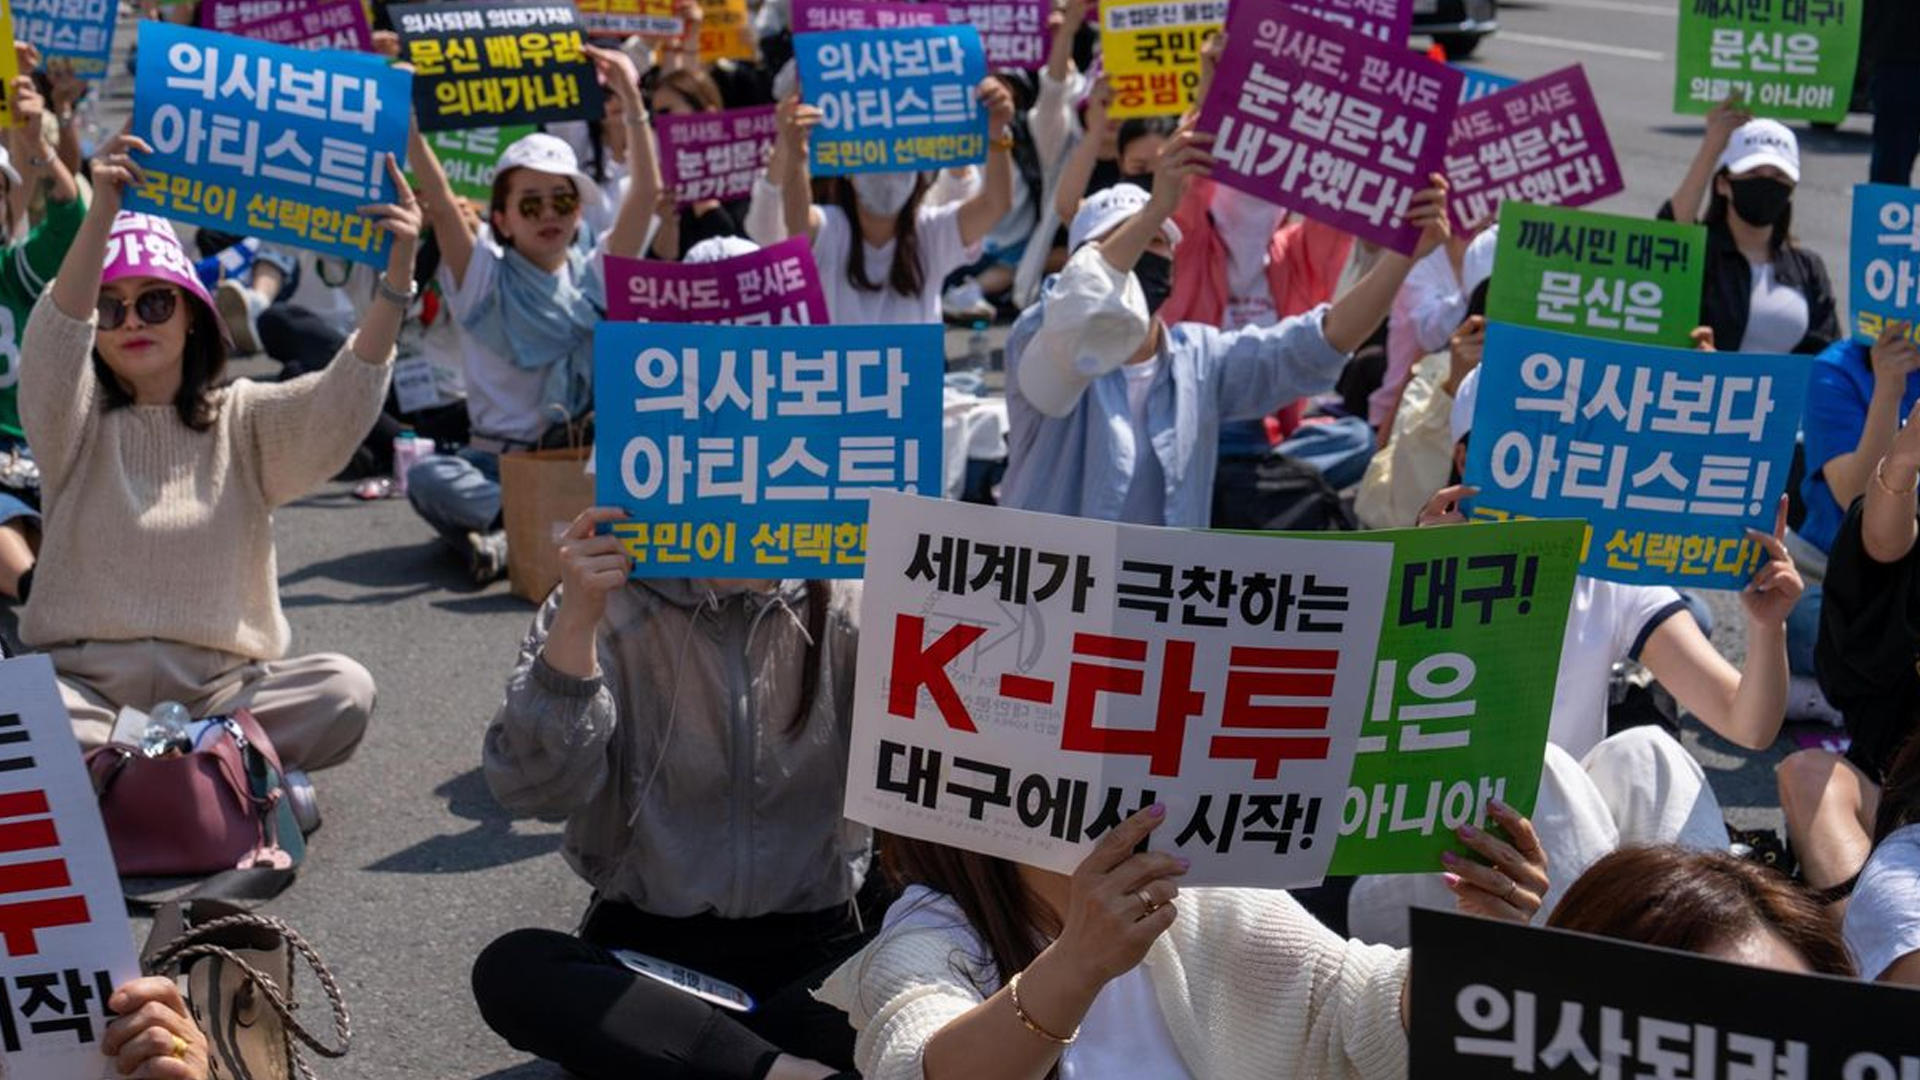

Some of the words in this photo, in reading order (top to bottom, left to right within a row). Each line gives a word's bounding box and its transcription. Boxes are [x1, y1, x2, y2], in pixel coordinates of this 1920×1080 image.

[409, 37, 480, 75] 문신
[817, 36, 965, 83] 의사보다
[1135, 28, 1220, 66] 국민
[1253, 19, 1349, 83] 의사도,
[1358, 55, 1442, 114] 판사도
[1711, 29, 1820, 74] 문신은
[166, 42, 384, 134] 의사보다
[435, 73, 580, 116] 의대가냐!
[817, 84, 978, 131] 아티스트!
[1237, 62, 1427, 174] 눈썹문신
[1503, 82, 1578, 126] 판사도
[1760, 83, 1834, 109] 아니야!
[150, 104, 384, 200] 아티스트!
[817, 139, 888, 167] 국민이
[894, 134, 983, 164] 선택한다!
[1211, 115, 1414, 229] 내가했다!
[1443, 113, 1589, 193] 눈썹문신
[136, 169, 236, 221] 국민이
[246, 195, 385, 253] 선택한다!
[1517, 220, 1616, 265] 깨시민
[1626, 235, 1689, 273] 대구!
[628, 276, 729, 309] 의사도,
[736, 257, 807, 304] 판사도
[1536, 270, 1663, 334] 문신은
[634, 348, 910, 420] 의사보다
[1515, 353, 1775, 441] 의사보다
[620, 436, 920, 505] 아티스트!
[1491, 431, 1771, 517] 아티스트!
[611, 522, 737, 563] 국민이
[1605, 529, 1761, 577] 선택한다!
[904, 533, 1095, 613] 세계가
[1116, 560, 1349, 632] 극찬하는
[1398, 554, 1539, 630] 대구!
[887, 613, 1340, 779] K-타투
[1175, 793, 1322, 853] 시작!
